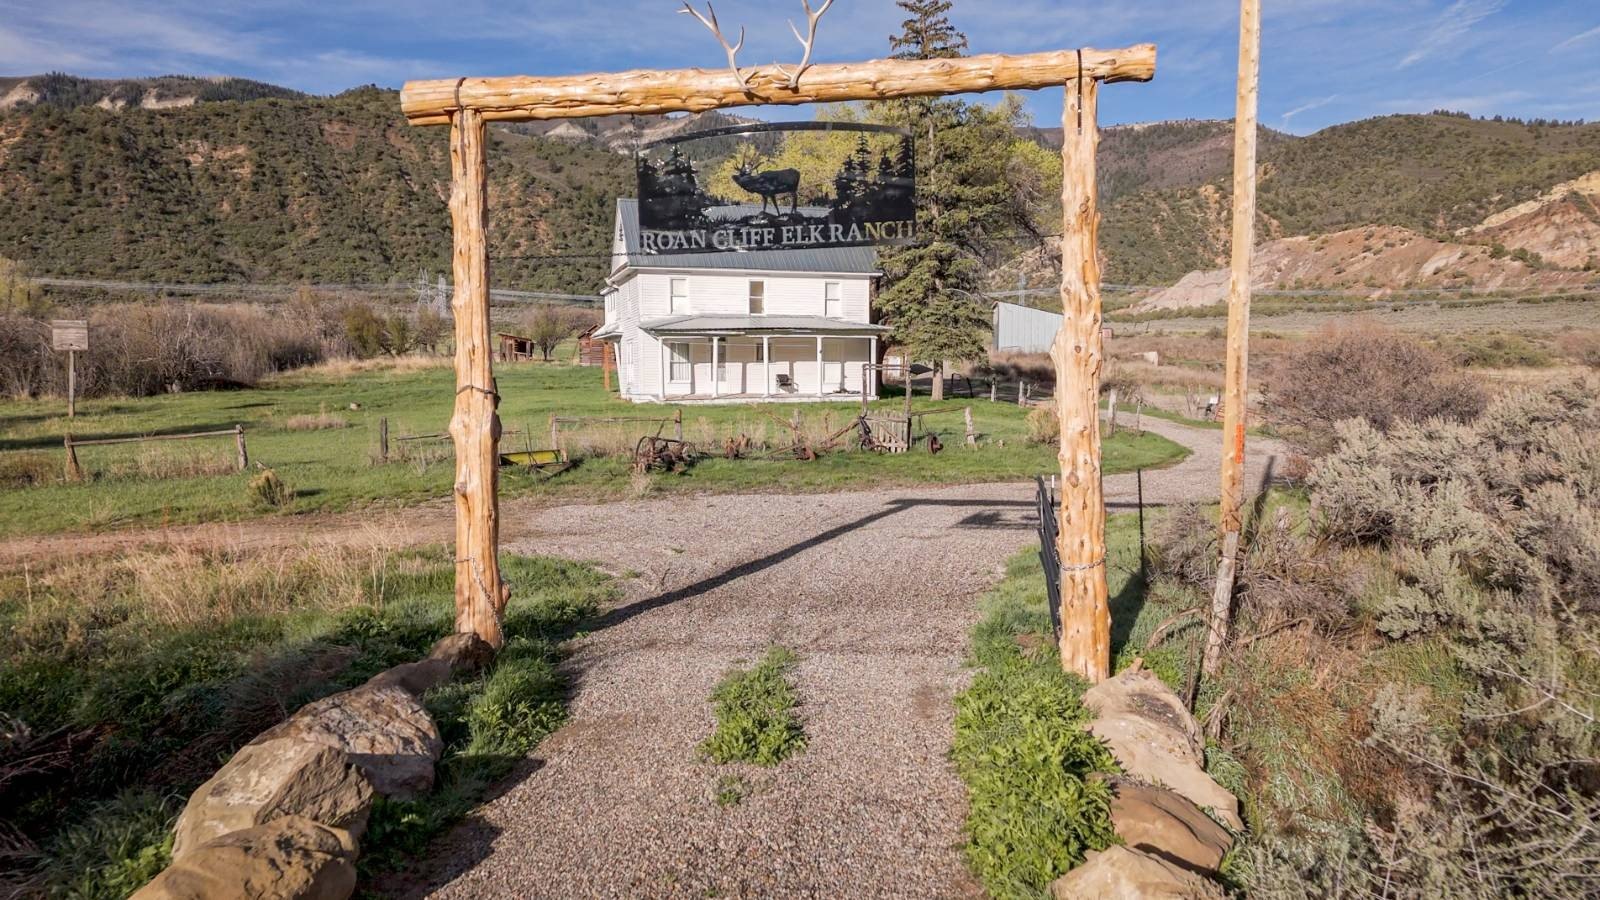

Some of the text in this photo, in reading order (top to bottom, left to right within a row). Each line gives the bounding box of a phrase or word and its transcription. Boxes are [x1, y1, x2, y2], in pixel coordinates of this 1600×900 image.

[642, 220, 914, 251] ROAN CLIFF ELK RANCH
